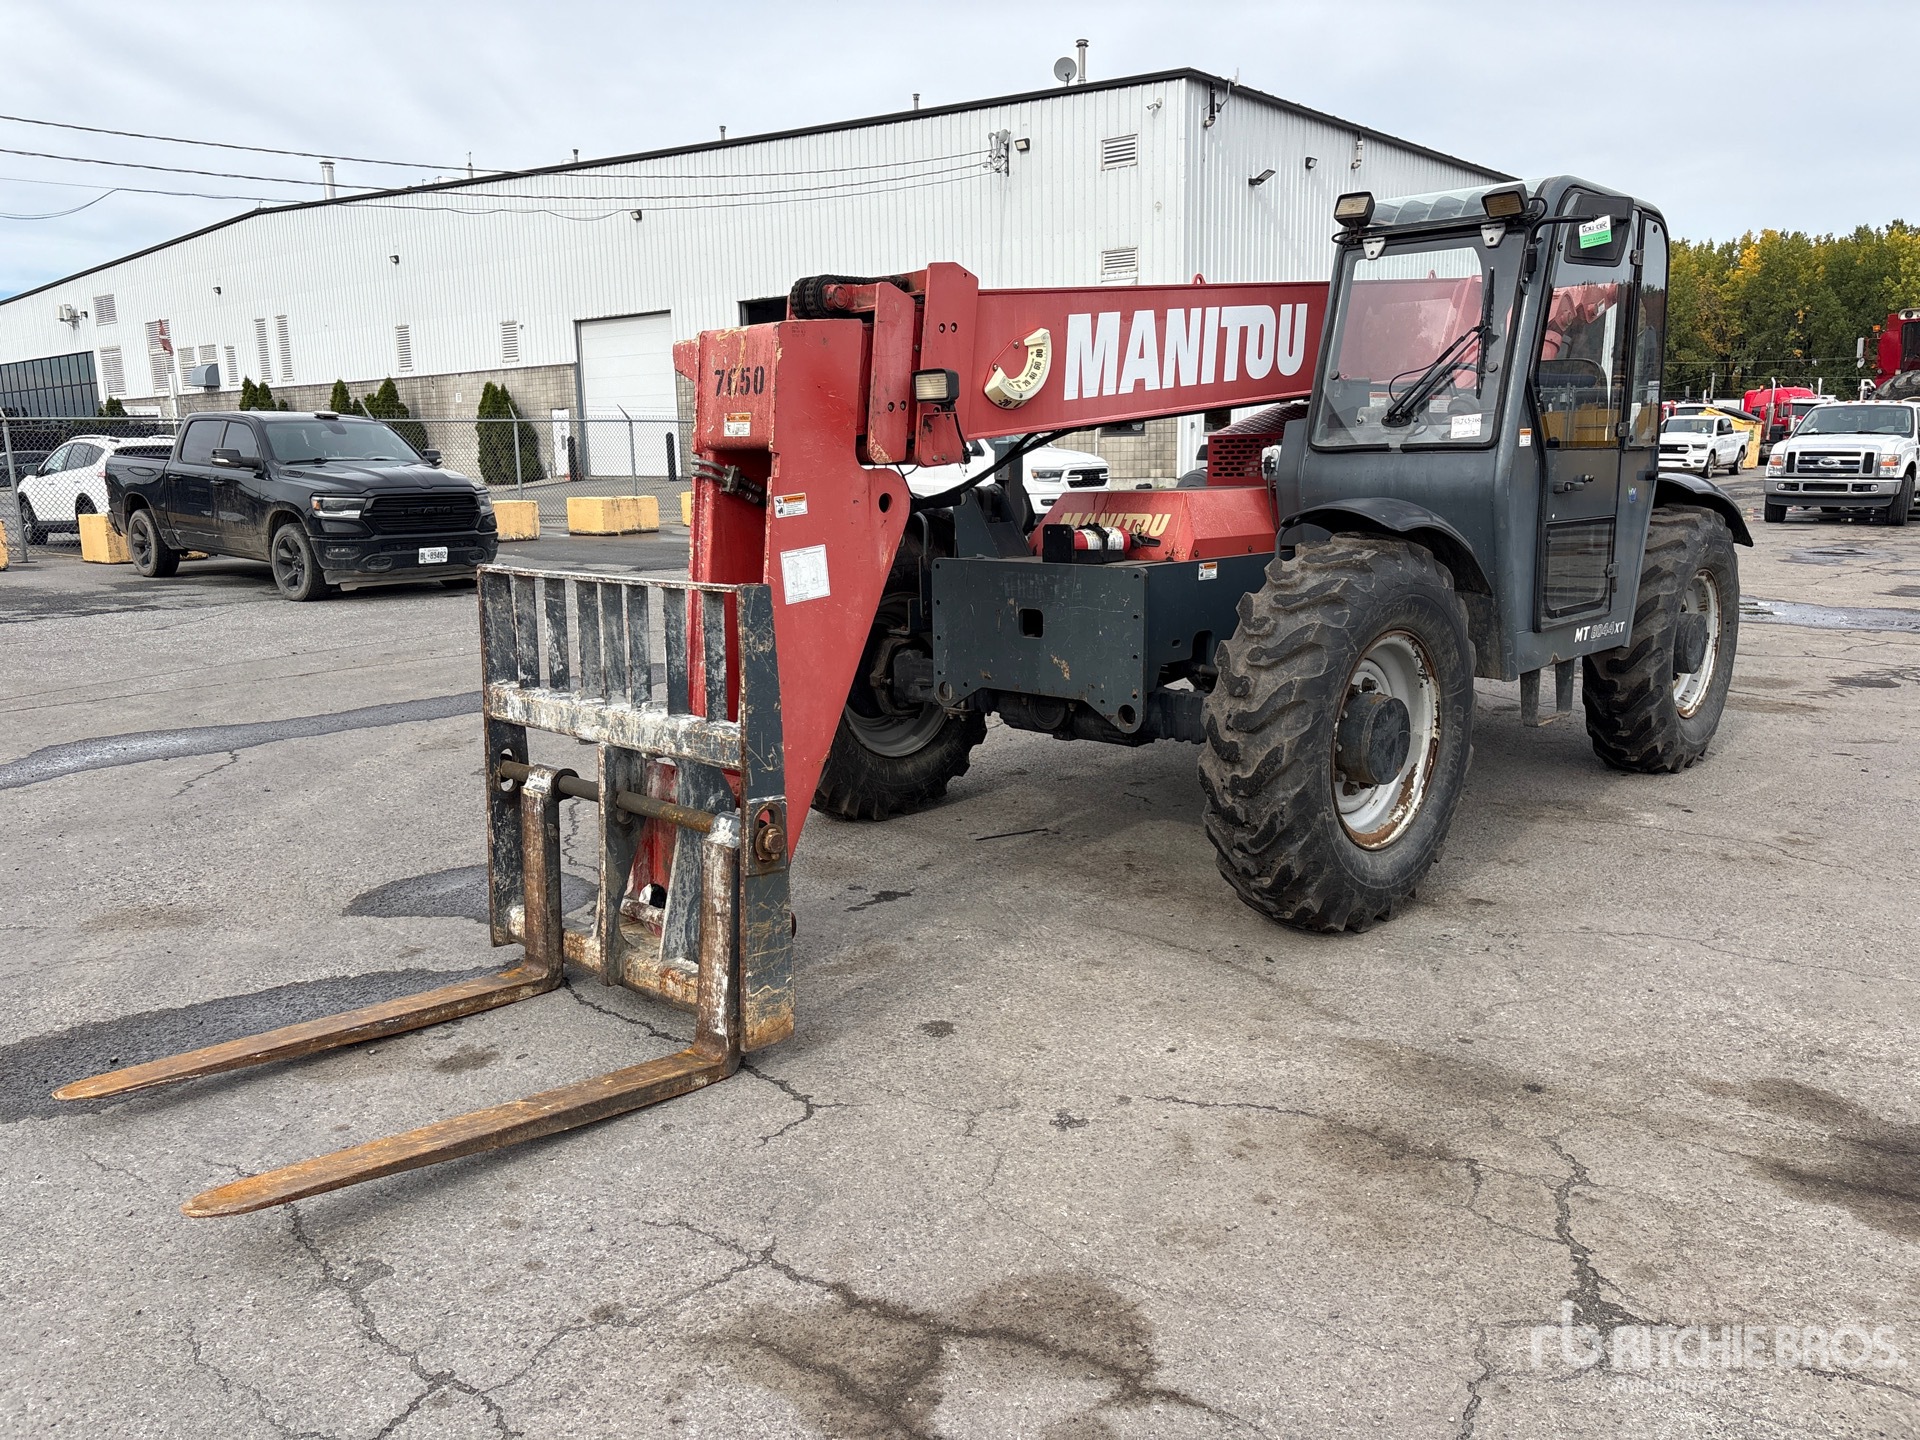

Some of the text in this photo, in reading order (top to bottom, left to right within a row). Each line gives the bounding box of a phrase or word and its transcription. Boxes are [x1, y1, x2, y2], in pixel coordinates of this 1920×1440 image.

[1035, 348, 1043, 358] 80
[1064, 304, 1308, 401] MANITOU
[1033, 361, 1042, 371] 60
[1574, 625, 1591, 643] MT
